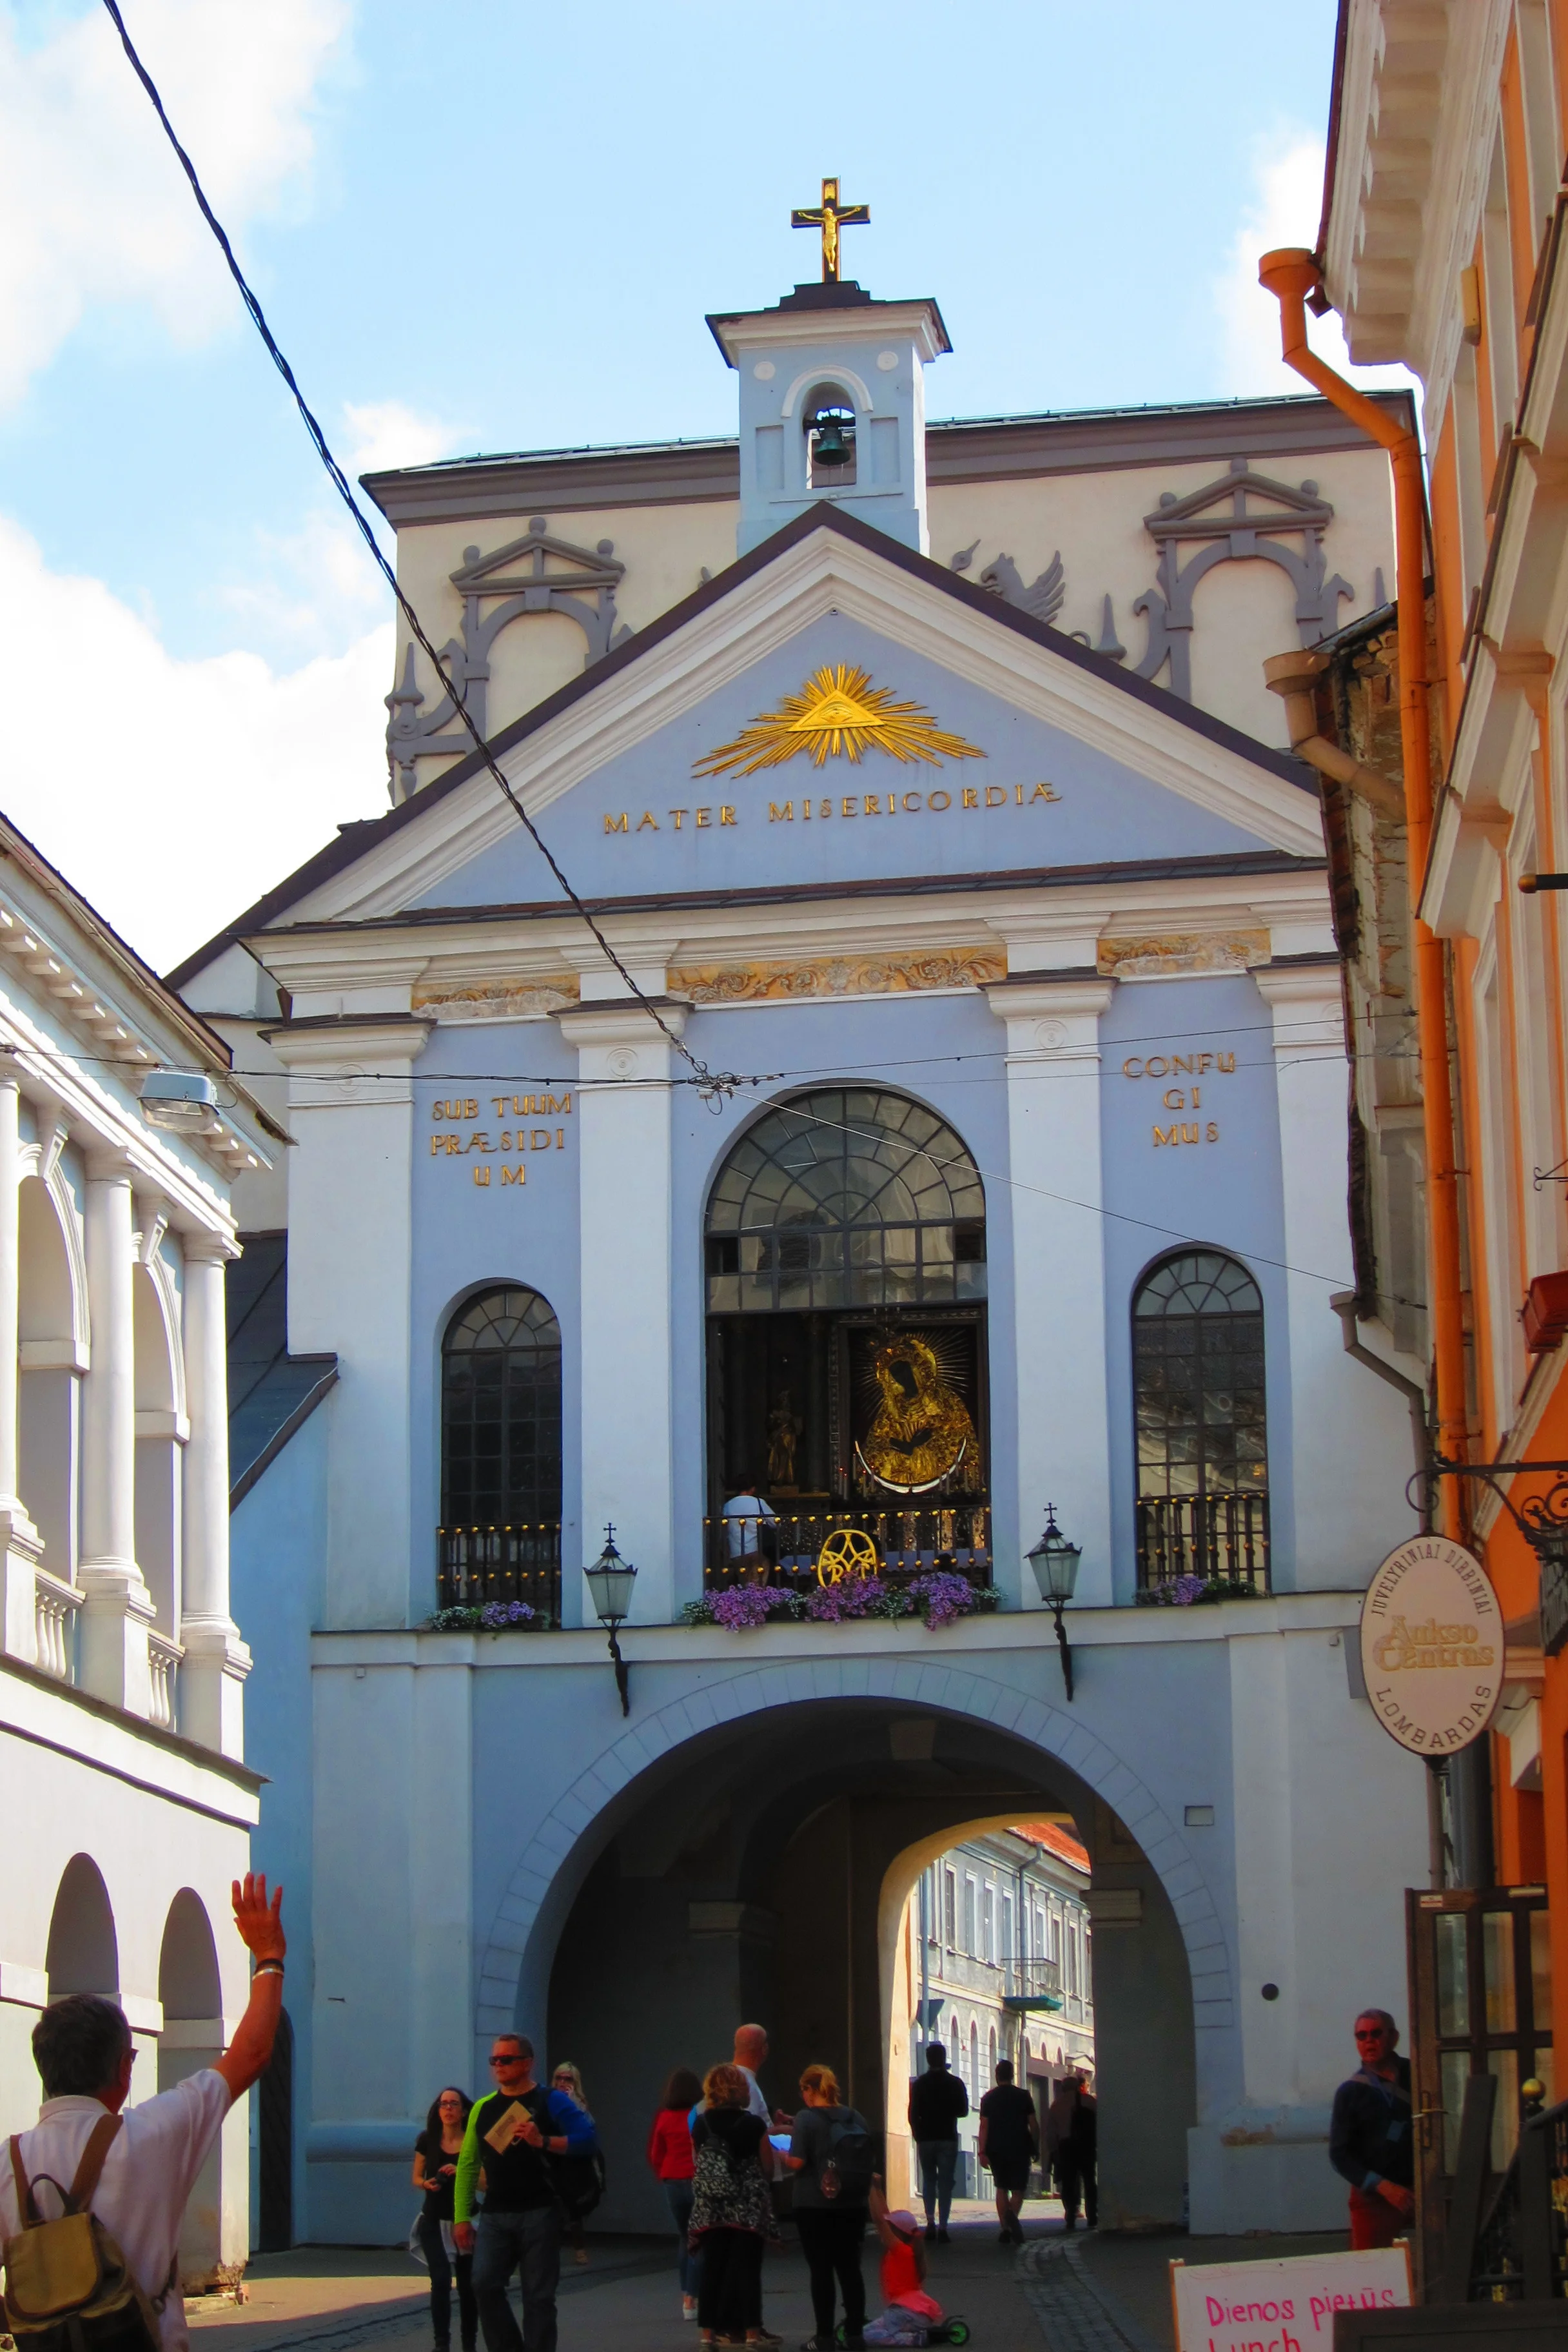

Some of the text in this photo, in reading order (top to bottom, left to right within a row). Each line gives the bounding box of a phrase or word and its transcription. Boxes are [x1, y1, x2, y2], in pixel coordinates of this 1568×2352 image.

[604, 783, 1063, 834] MATER MISERICORDIÆ
[1123, 1052, 1235, 1077] CONFU
[432, 1093, 572, 1121] SUB TUUM
[1163, 1087, 1200, 1110] GI
[431, 1128, 564, 1155] PRÆSIDI
[1152, 1122, 1219, 1146] MUS
[474, 1164, 526, 1186] UM
[1371, 1544, 1492, 1617] JUVELYRINIAI DIRBINIAI
[1376, 1685, 1491, 1748] LOMBARDAS
[1206, 2296, 1295, 2326] Dienos
